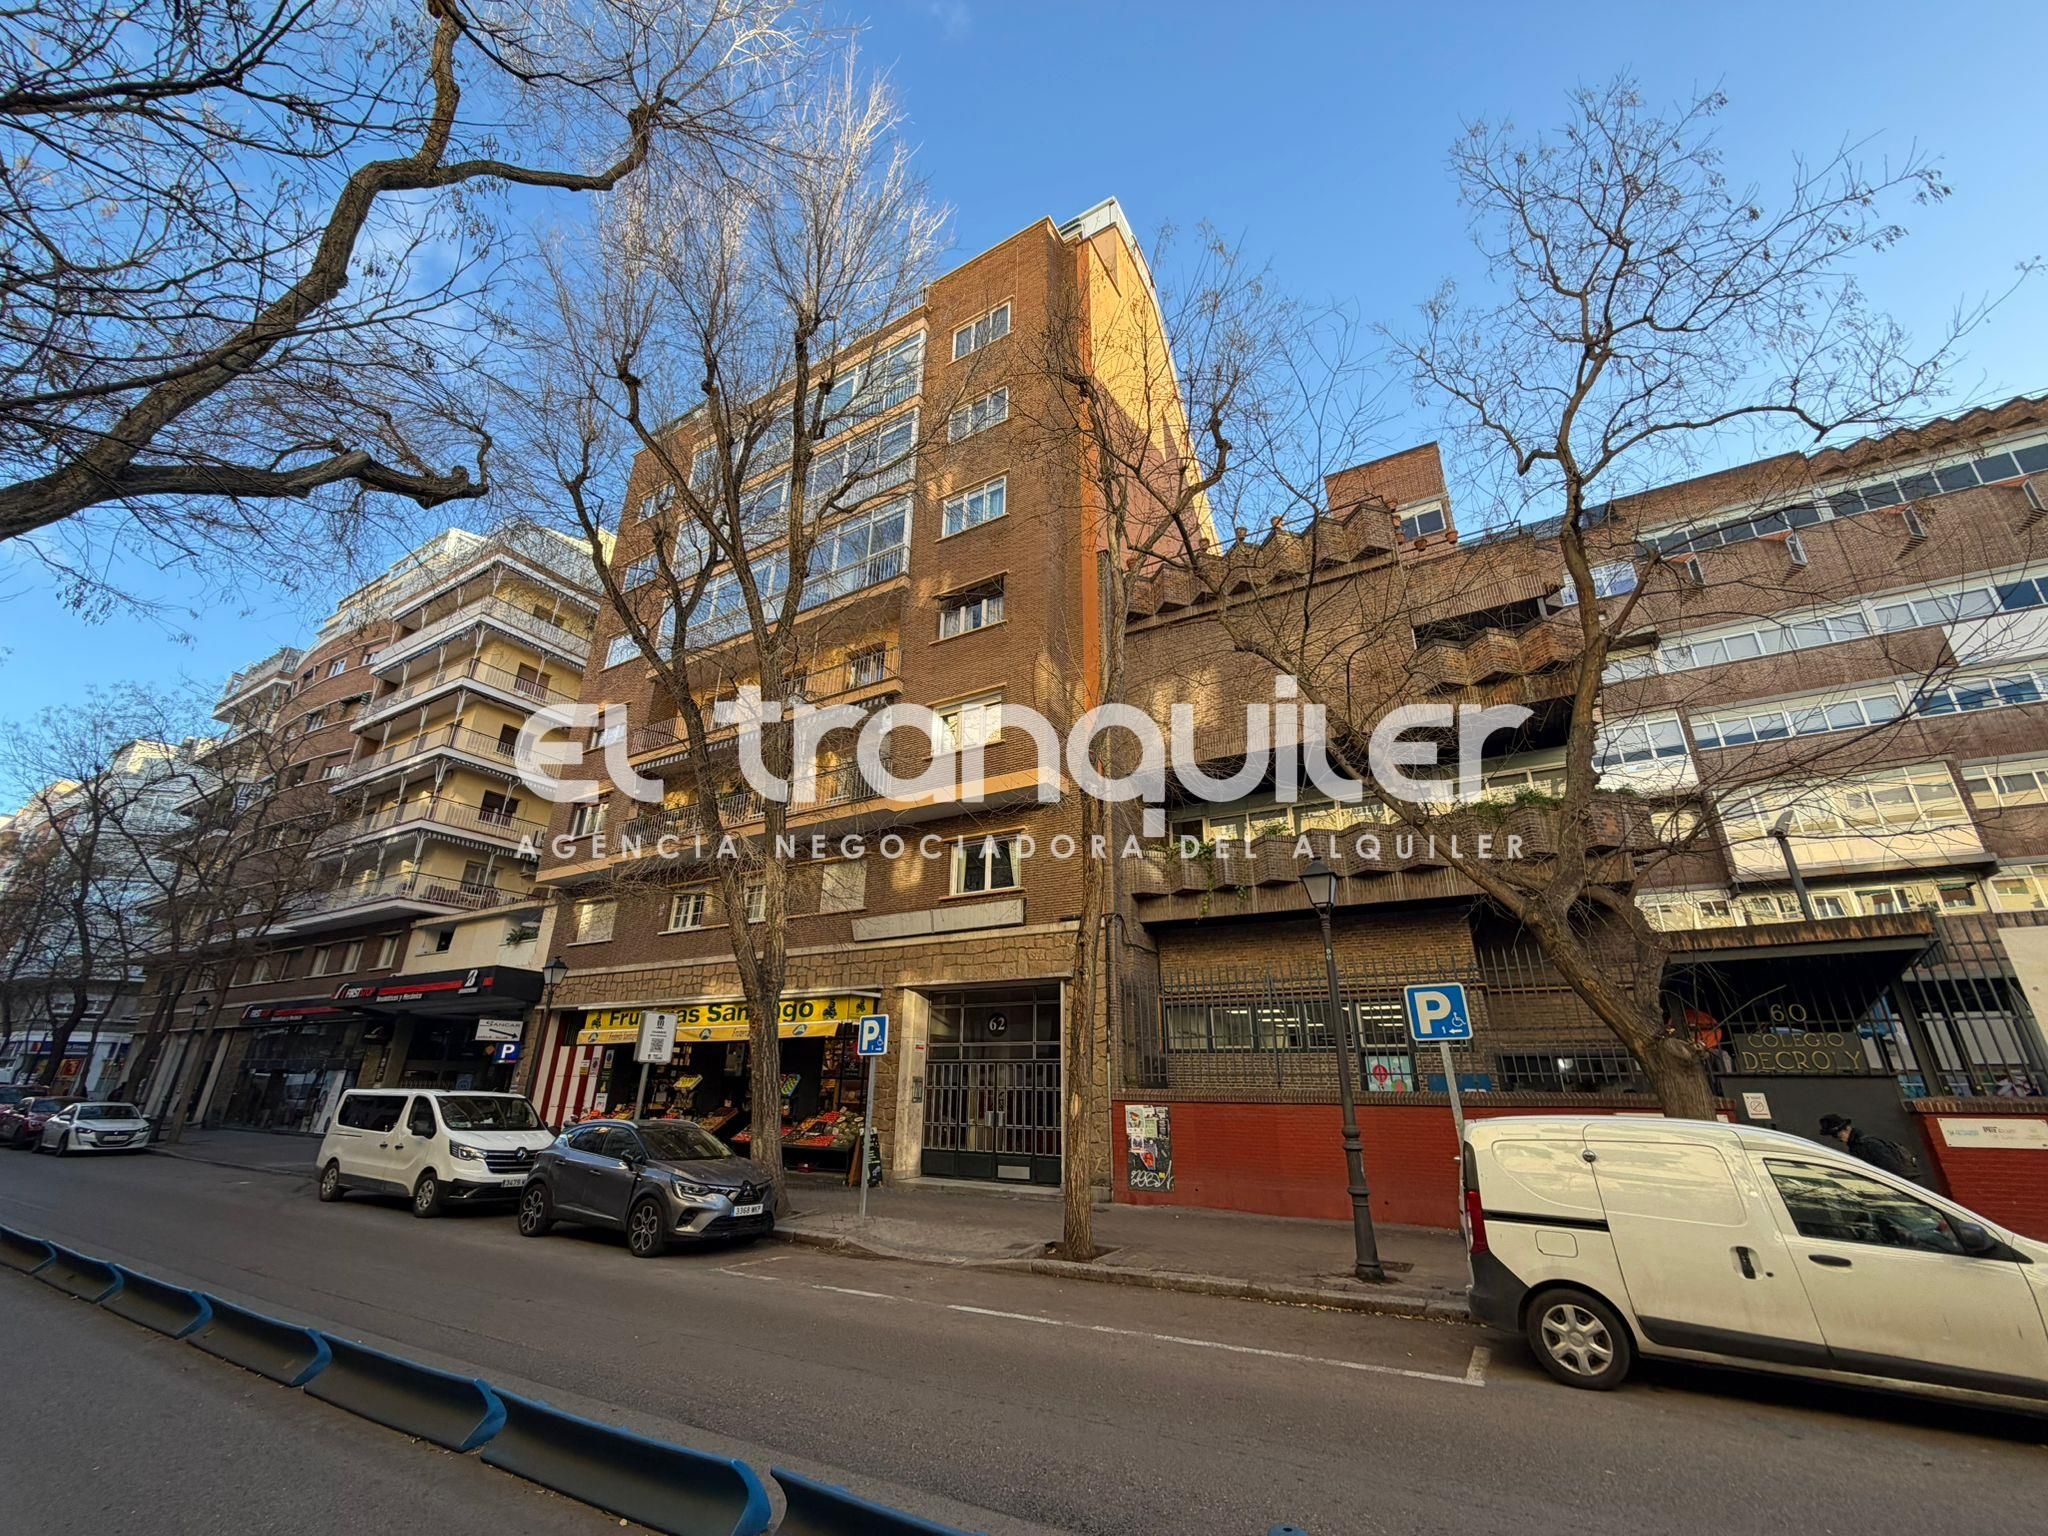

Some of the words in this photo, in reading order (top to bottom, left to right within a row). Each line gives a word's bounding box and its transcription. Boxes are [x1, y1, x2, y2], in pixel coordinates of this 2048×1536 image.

[1414, 991, 1451, 1034] P
[1770, 1003, 1807, 1022] 60
[988, 1017, 1006, 1031] 62
[1442, 1026, 1447, 1034] 1
[861, 1020, 880, 1050] P
[1748, 1032, 1845, 1048] COLEGIO
[501, 1044, 515, 1058] P
[1742, 1051, 1861, 1070] DECROLY
